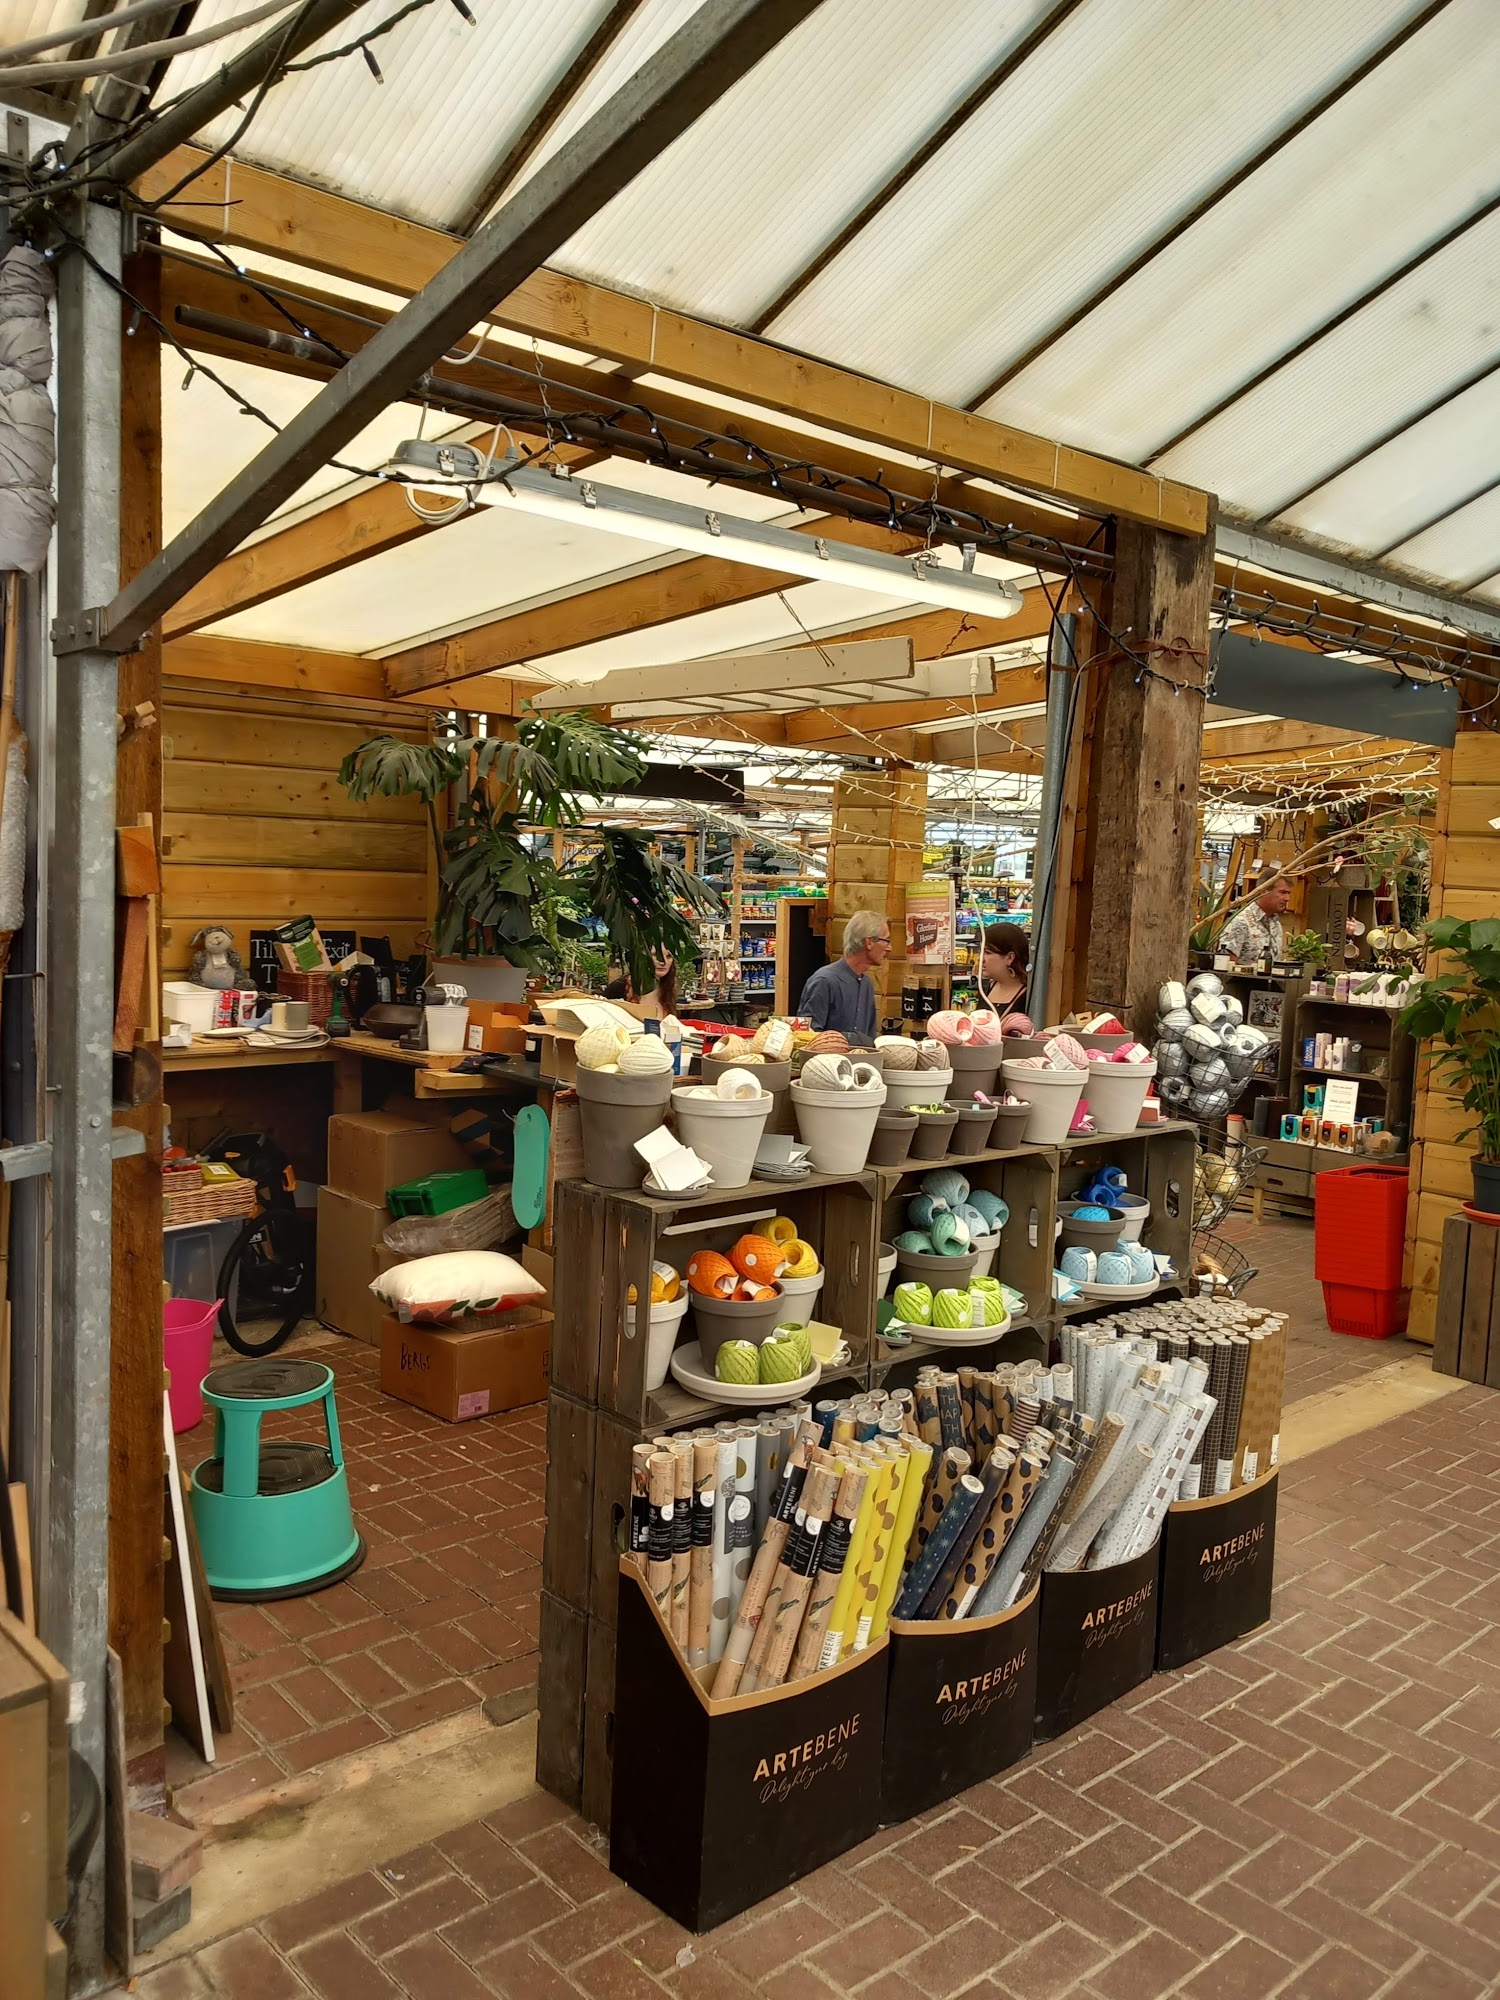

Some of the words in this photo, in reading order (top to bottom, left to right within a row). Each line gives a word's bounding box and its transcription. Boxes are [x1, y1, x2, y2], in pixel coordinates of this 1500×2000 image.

[251, 939, 277, 959] Til
[322, 938, 350, 959] Exit
[903, 997, 915, 1012] 13
[922, 995, 933, 1013] 14
[401, 1343, 431, 1371] BERGS
[1199, 1522, 1265, 1565] ARTEBENE
[1080, 1579, 1153, 1630] ARTEBENE
[935, 1647, 1028, 1704] ARTEBENE
[752, 1713, 860, 1782] ARTEBENE
